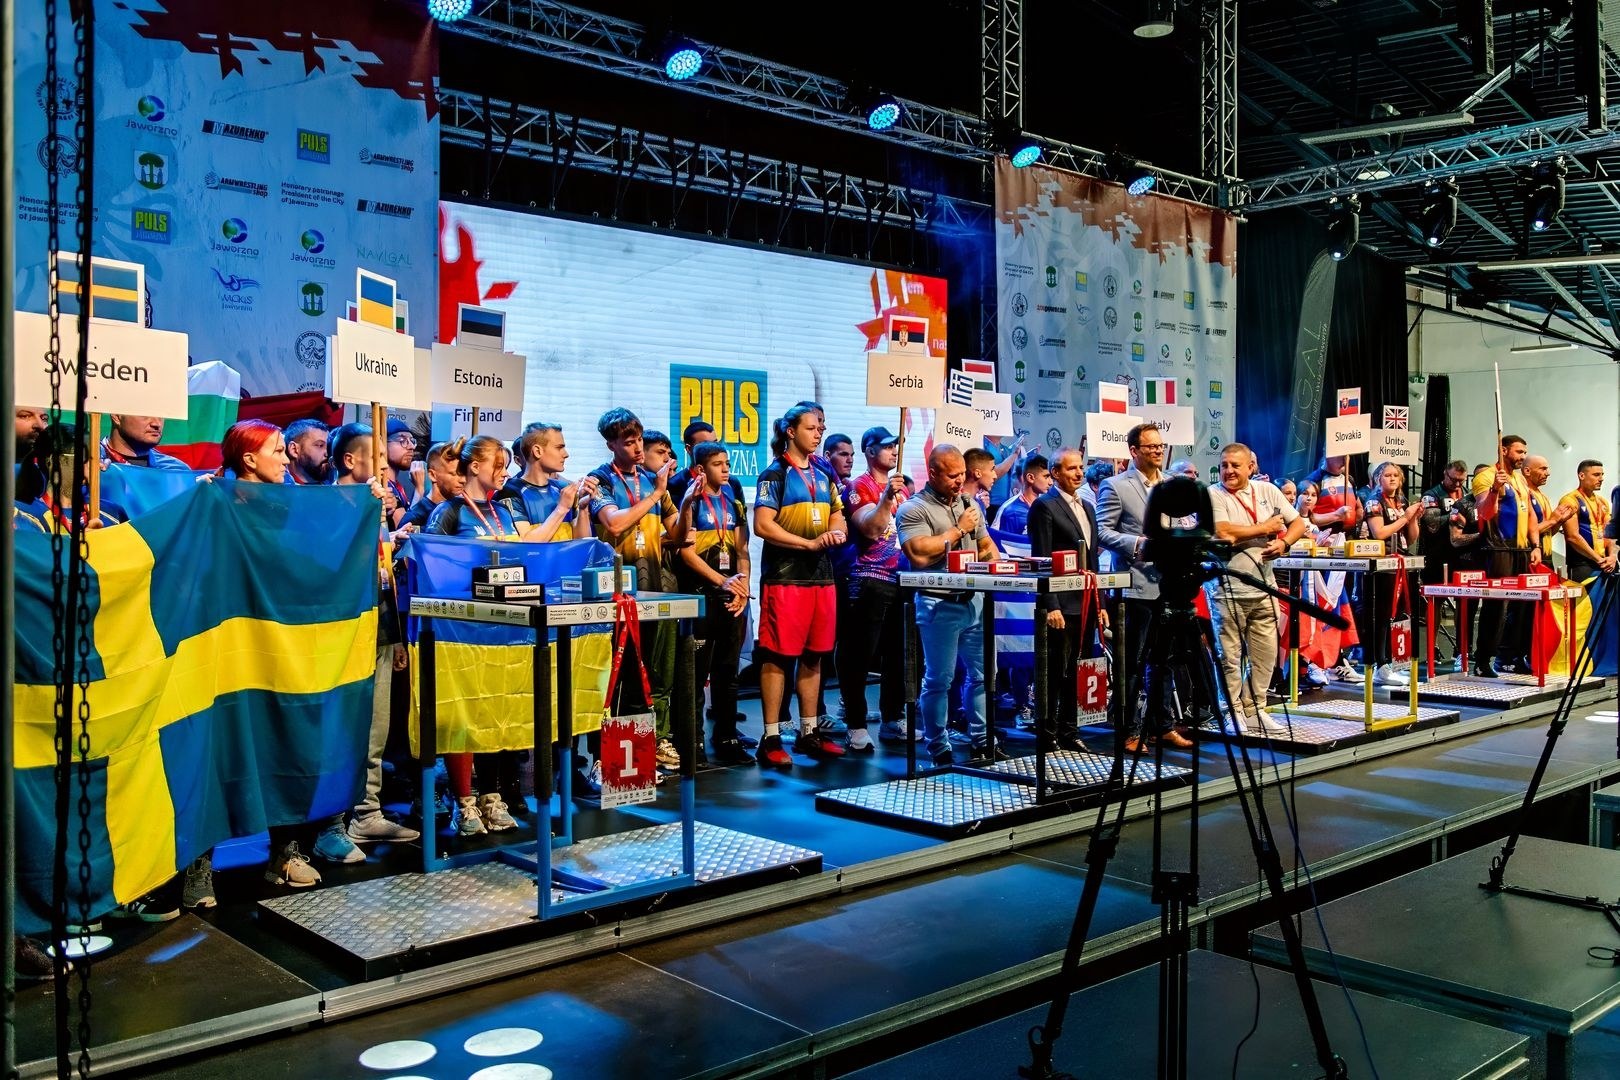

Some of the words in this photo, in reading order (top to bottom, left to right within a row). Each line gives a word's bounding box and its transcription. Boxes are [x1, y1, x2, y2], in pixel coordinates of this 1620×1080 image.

[125, 118, 178, 136] Jaworzno
[300, 132, 328, 153] PULS
[220, 177, 268, 191] ARMWRESTLING
[135, 211, 168, 233] PULS
[211, 241, 260, 256] Jaworzno
[290, 252, 336, 267] Jaworzno
[355, 352, 398, 378] Ukraine
[454, 368, 503, 389] Estonia
[889, 374, 923, 389] Serbia
[454, 408, 503, 422] Finand
[680, 377, 760, 445] PULS
[946, 422, 972, 439] Greece
[1335, 430, 1362, 442] Slovakia
[1379, 446, 1411, 458] Kingdom
[1397, 634, 1405, 656] 3
[1086, 675, 1098, 705] 2
[619, 739, 638, 777] 1
